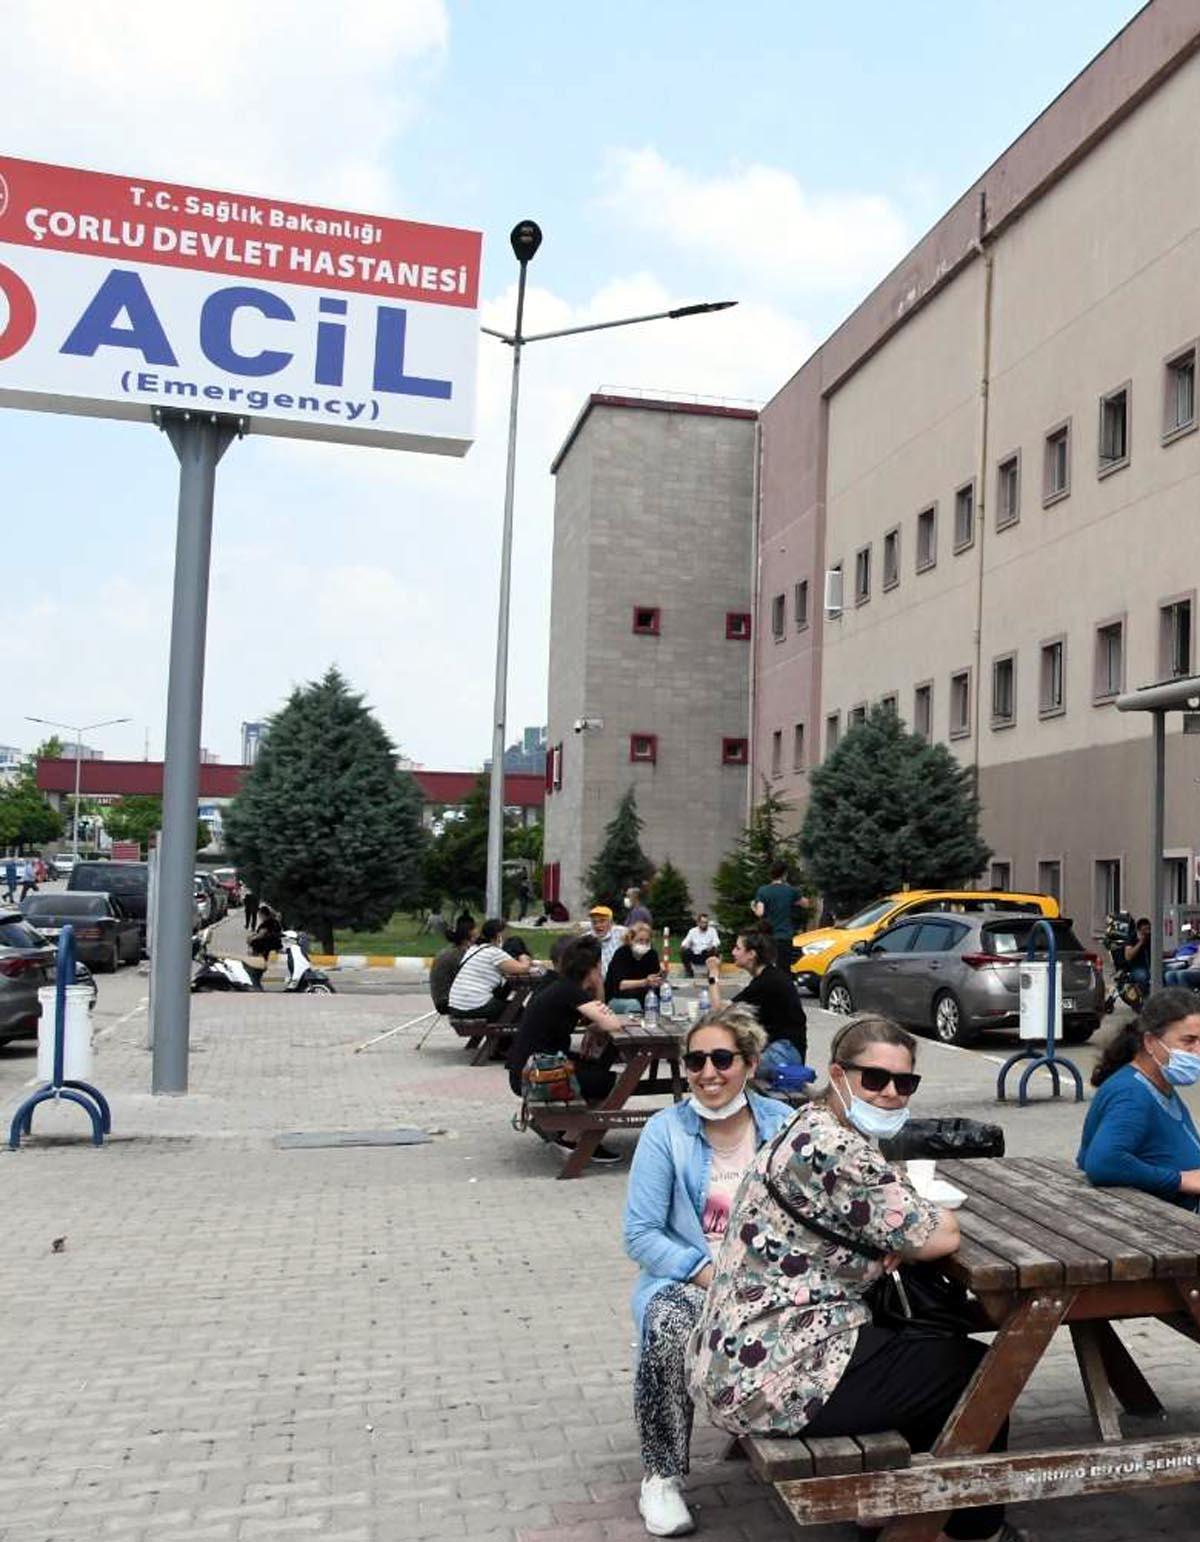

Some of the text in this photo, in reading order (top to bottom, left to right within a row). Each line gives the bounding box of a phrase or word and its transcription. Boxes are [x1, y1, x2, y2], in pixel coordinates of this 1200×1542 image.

[25, 207, 468, 295] ÇORLU DEVLET HASTANESİ
[130, 186, 382, 244] T.C. Sağlık Bakanlığı
[58, 268, 453, 400] ACİL
[120, 370, 381, 421] (Emergency)
